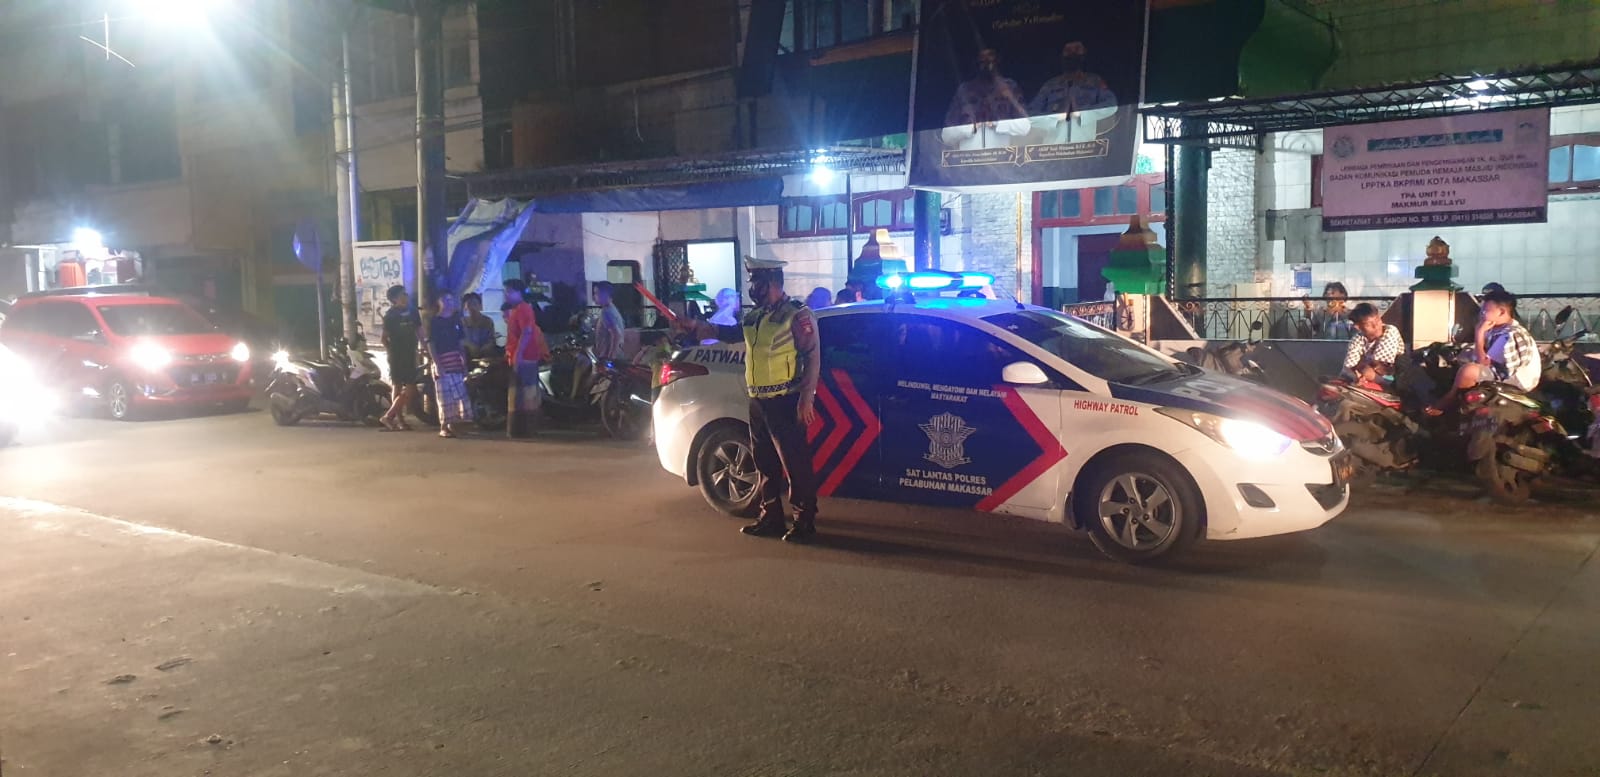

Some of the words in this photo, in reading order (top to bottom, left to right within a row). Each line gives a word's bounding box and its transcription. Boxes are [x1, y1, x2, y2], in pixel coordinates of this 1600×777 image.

[1400, 168, 1430, 177] PEMUDA
[1427, 176, 1449, 186] KOTA
[1452, 174, 1500, 184] MAKASSAR
[1391, 200, 1428, 208] MAKMUR
[1430, 198, 1466, 206] MELAYU
[694, 350, 746, 364] PATWAL
[1074, 400, 1109, 412] HIGHWAY
[1110, 403, 1139, 416] PATROL
[906, 468, 921, 477] SAT
[922, 470, 953, 480] LANTAS
[954, 473, 986, 484] POLRES
[899, 478, 947, 490] PELABUHAN
[947, 483, 993, 496] MAKASSAR
